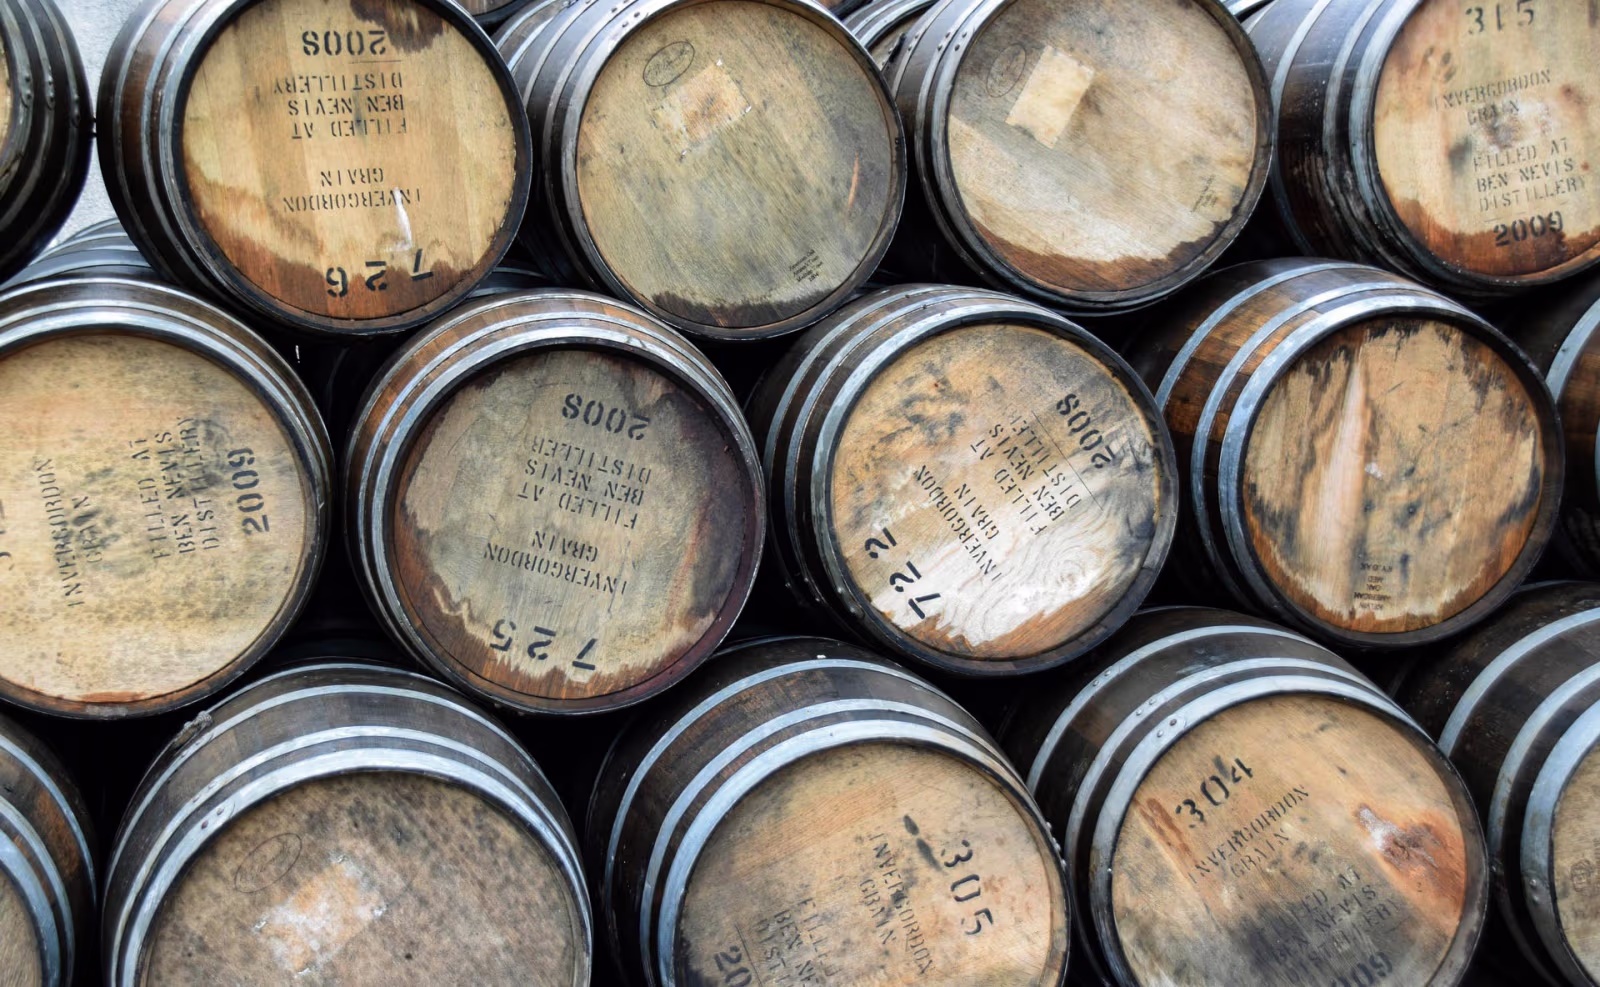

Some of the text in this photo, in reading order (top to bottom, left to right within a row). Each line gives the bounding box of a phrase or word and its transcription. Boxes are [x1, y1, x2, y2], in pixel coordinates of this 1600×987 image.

[1466, 0, 1534, 35] 315
[273, 72, 403, 94] DISTILLERY
[289, 94, 404, 116] BEN NEVIS
[1434, 69, 1552, 112] INVERGORDON
[291, 119, 407, 139] FILLED AT
[320, 167, 384, 187] GRAIN
[1473, 137, 1568, 172] FILLED AT
[1476, 158, 1574, 193] BEN NEVIS
[283, 188, 420, 213] INVERGORDON
[1478, 176, 1586, 212] DISTILLERY
[1493, 211, 1563, 247] 2009
[326, 248, 433, 298] 726
[155, 431, 195, 554] BEN NEVIS
[177, 417, 219, 551] DISTILLERY
[227, 447, 270, 536] 2009
[525, 459, 643, 507] BEN NEVIS
[970, 439, 1047, 536] FILLED AT
[989, 424, 1065, 522] BEN NEVIS
[130, 438, 171, 560] FILLED AT
[517, 481, 638, 530] FILLED AT
[914, 465, 1002, 582] INVERGORDON
[954, 483, 1000, 540] GRAIN
[32, 457, 85, 607] INVERGORDON
[532, 530, 598, 563] GRAIN
[484, 542, 627, 595] INVERGORDON
[864, 527, 941, 619] 722
[490, 618, 598, 671] 725
[1175, 757, 1253, 829] 304
[1186, 784, 1310, 885] INVERGORDON
[1229, 828, 1290, 879] GRAIN
[859, 878, 897, 945] GRAIN
[940, 838, 994, 936] 305
[1314, 884, 1377, 933] NEVIS
[774, 909, 804, 950] BEN
